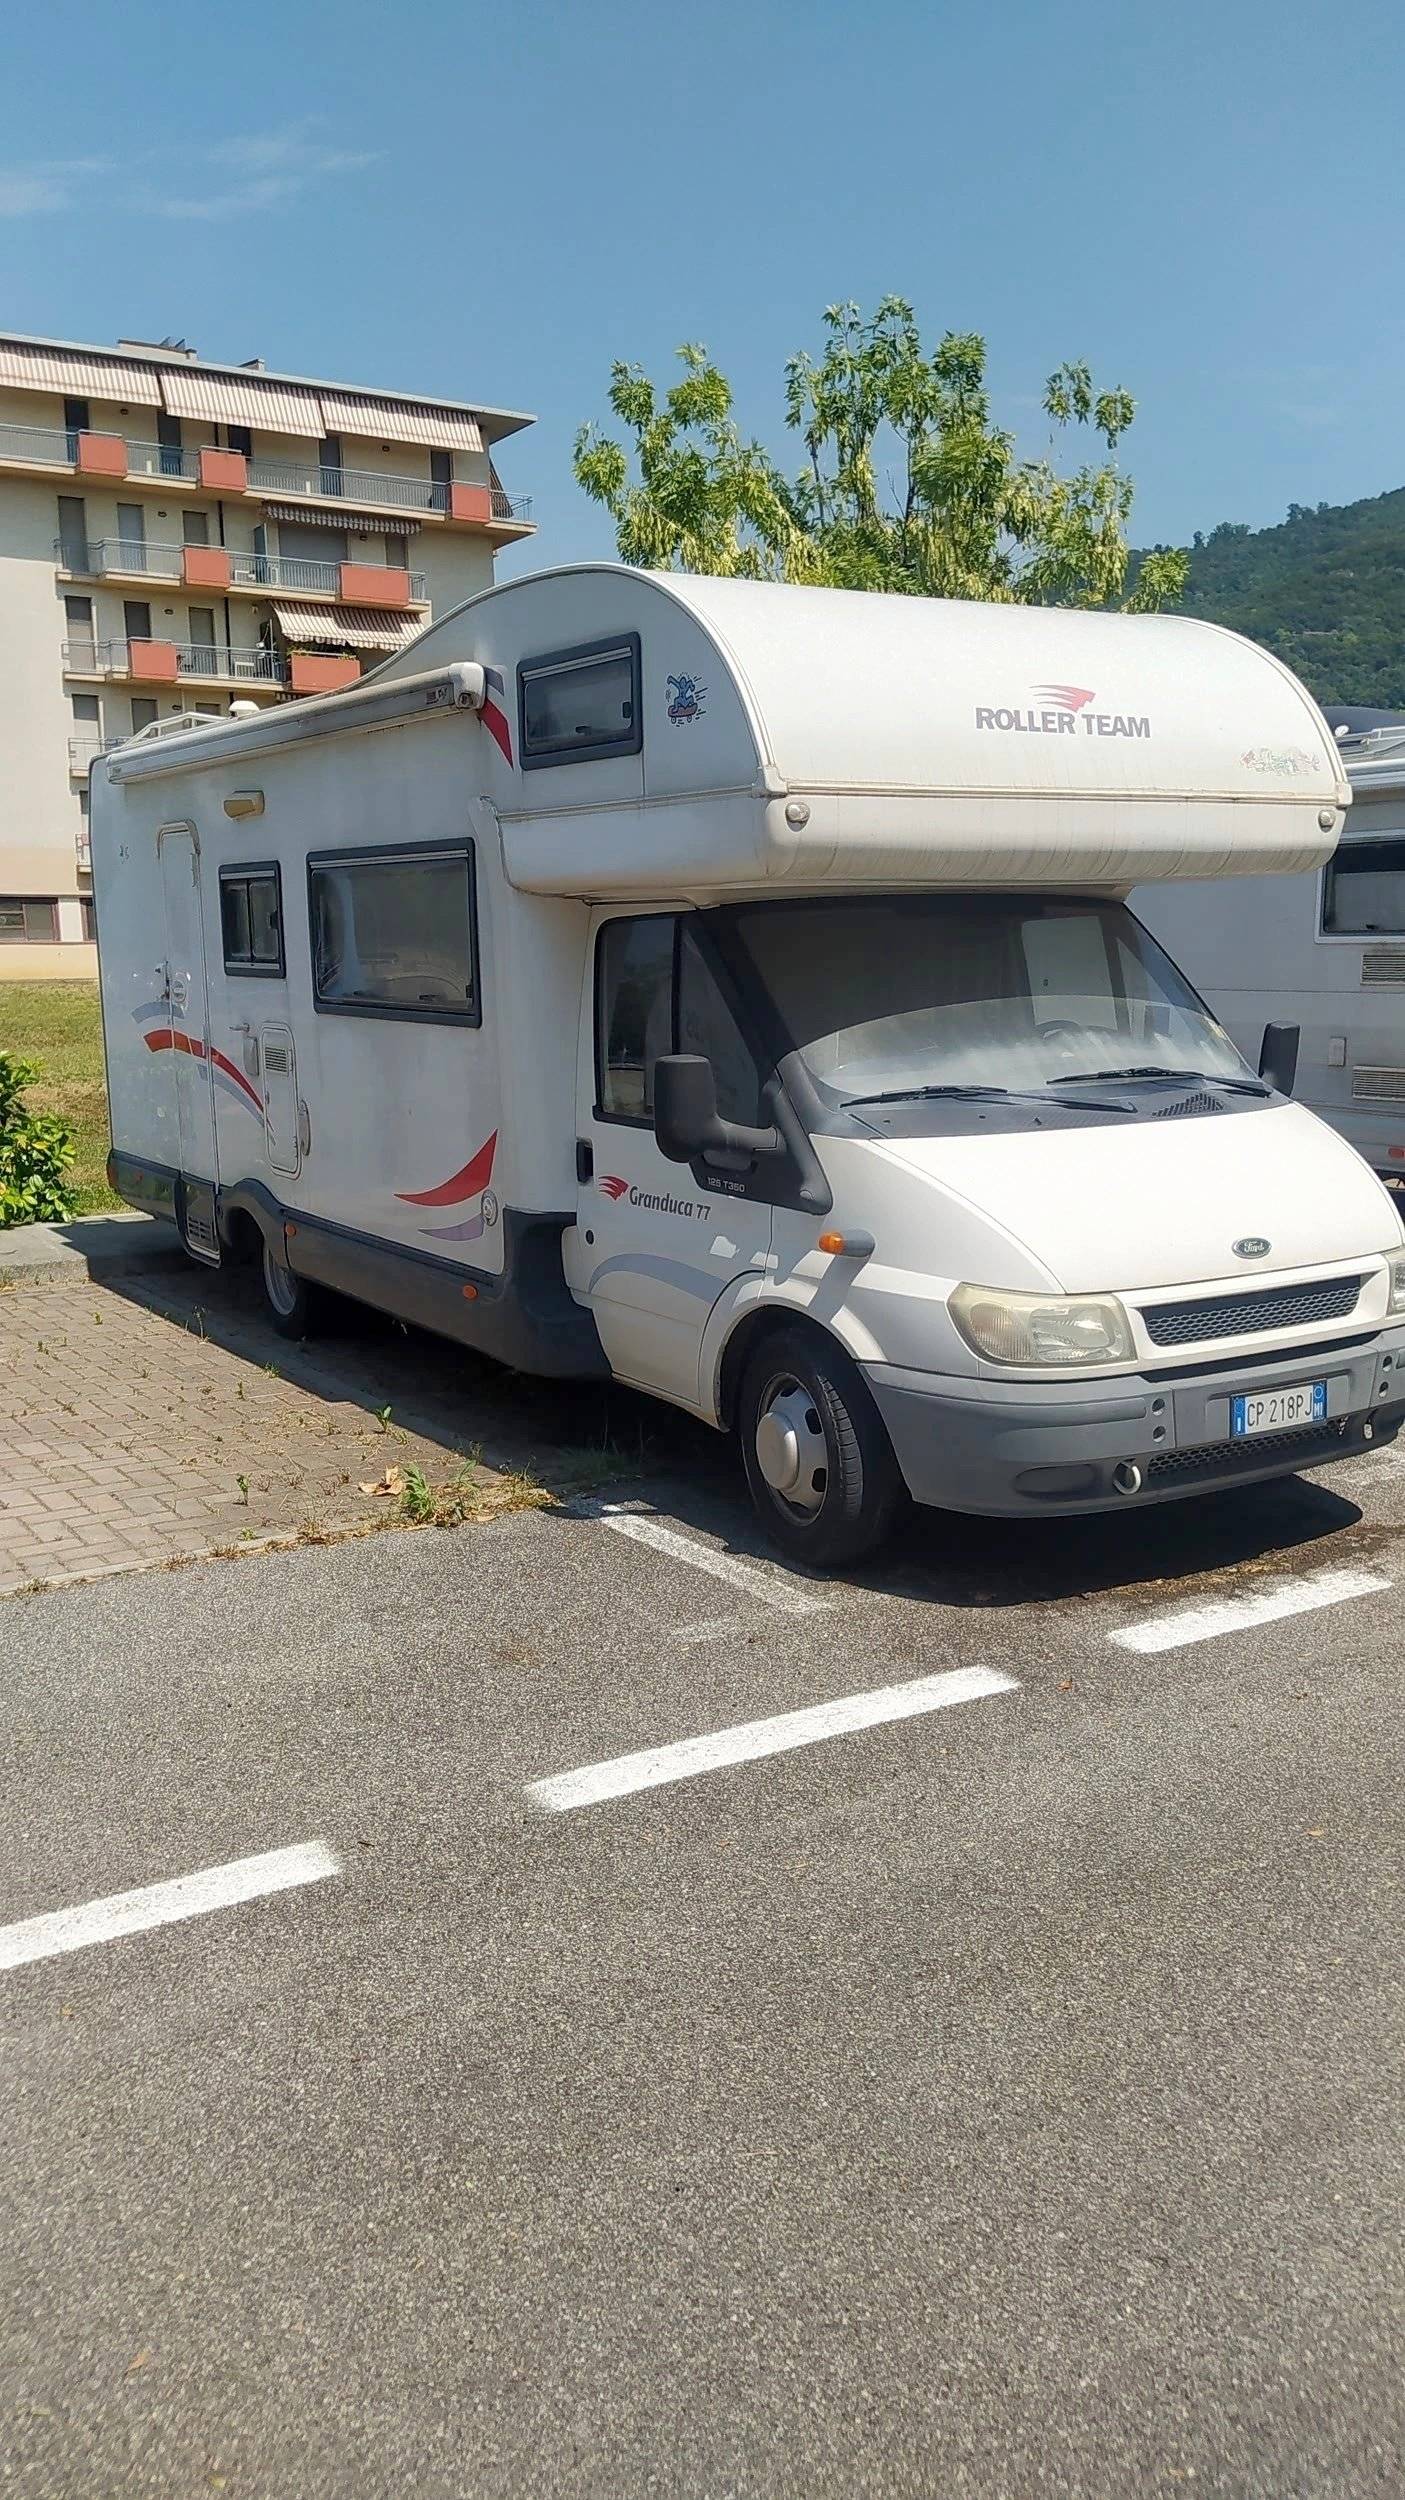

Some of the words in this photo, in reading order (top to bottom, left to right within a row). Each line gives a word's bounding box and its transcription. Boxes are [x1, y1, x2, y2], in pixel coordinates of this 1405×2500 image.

[975, 707, 1075, 734] ROLLER
[1081, 713, 1151, 738] TEAM
[708, 1177, 721, 1188] 125
[723, 1180, 745, 1192] T350
[629, 1185, 693, 1216] Granduca
[696, 1204, 711, 1220] 77
[1243, 1240, 1265, 1253] Ford
[1247, 1401, 1265, 1427] CP
